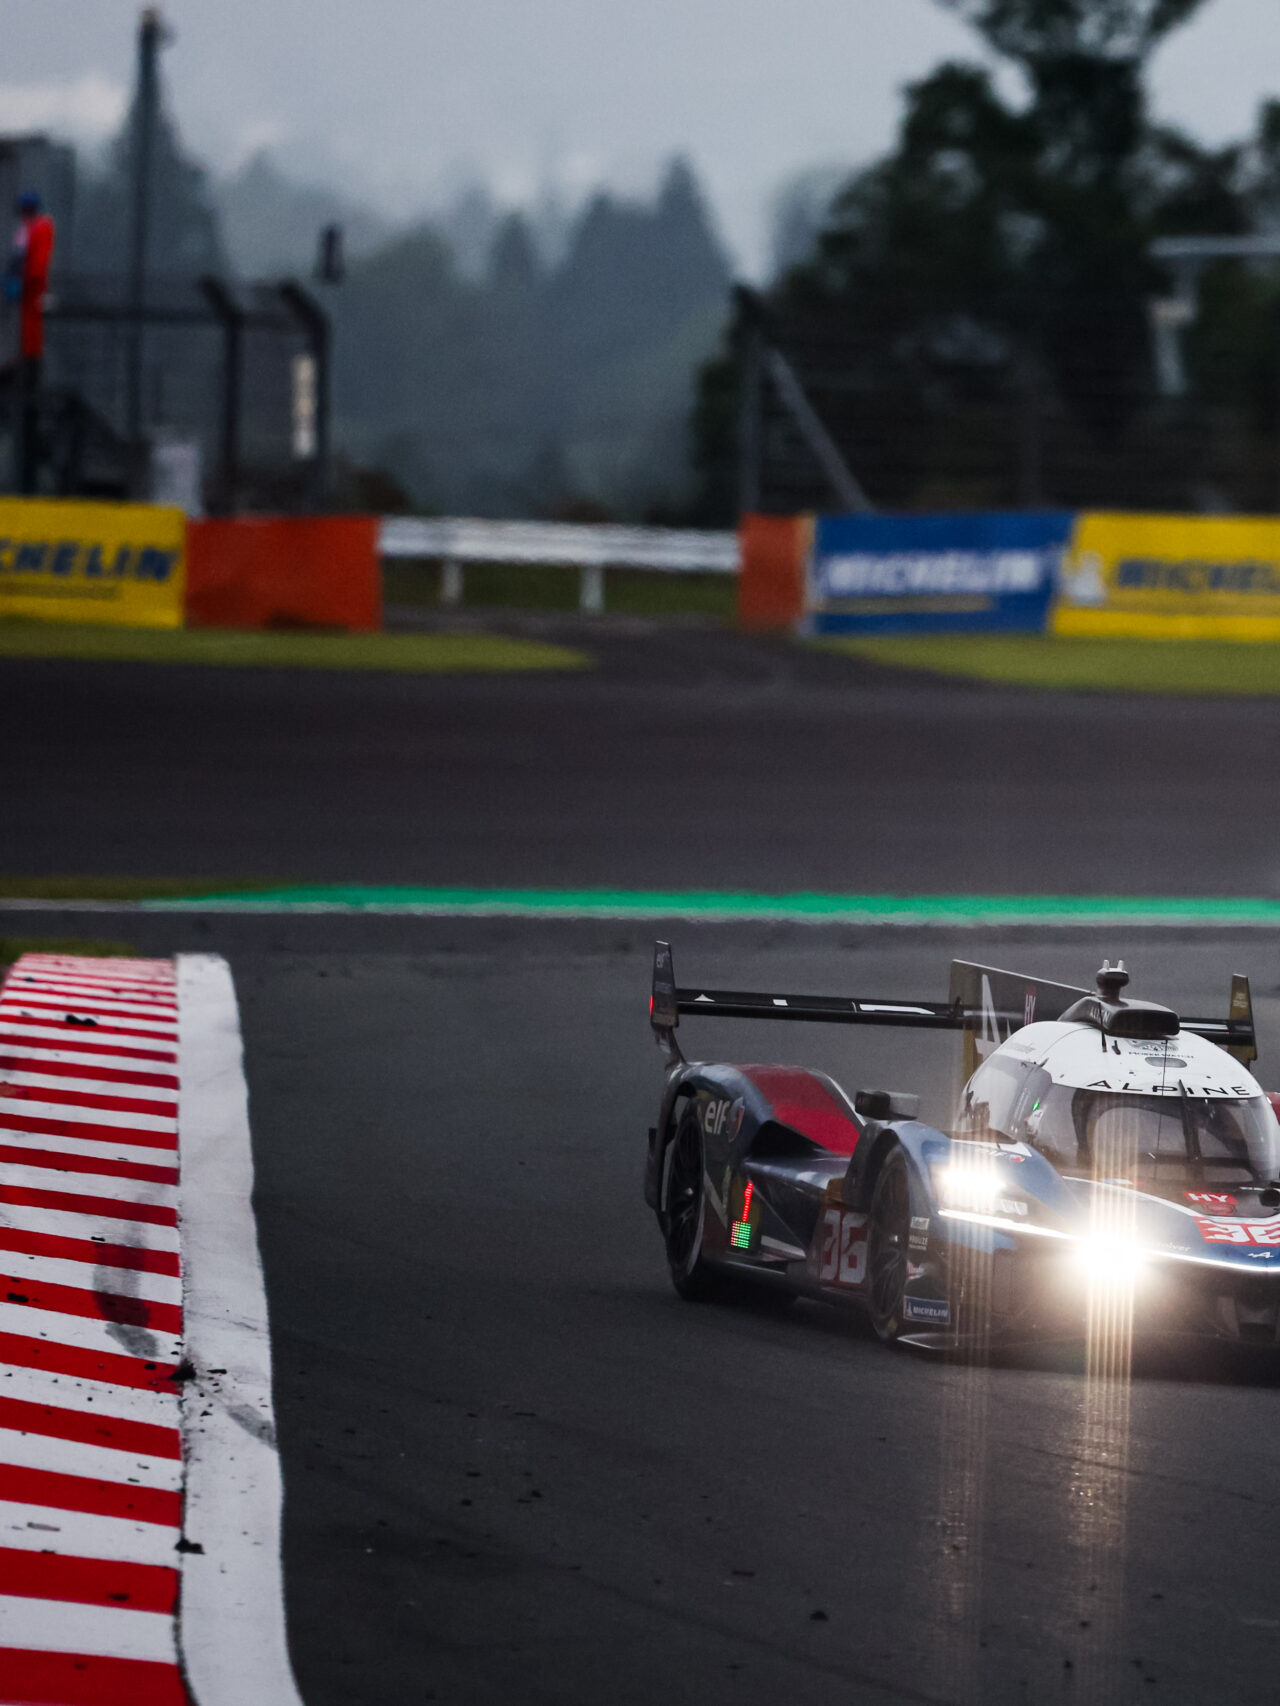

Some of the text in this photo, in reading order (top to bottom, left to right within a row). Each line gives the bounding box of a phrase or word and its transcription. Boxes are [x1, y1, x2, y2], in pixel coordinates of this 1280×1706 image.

[1087, 1080, 1250, 1096] ALPINE
[705, 1100, 728, 1135] elf
[1188, 1193, 1229, 1203] HY
[819, 1209, 869, 1284] 36
[913, 1306, 948, 1317] MICHELIN
